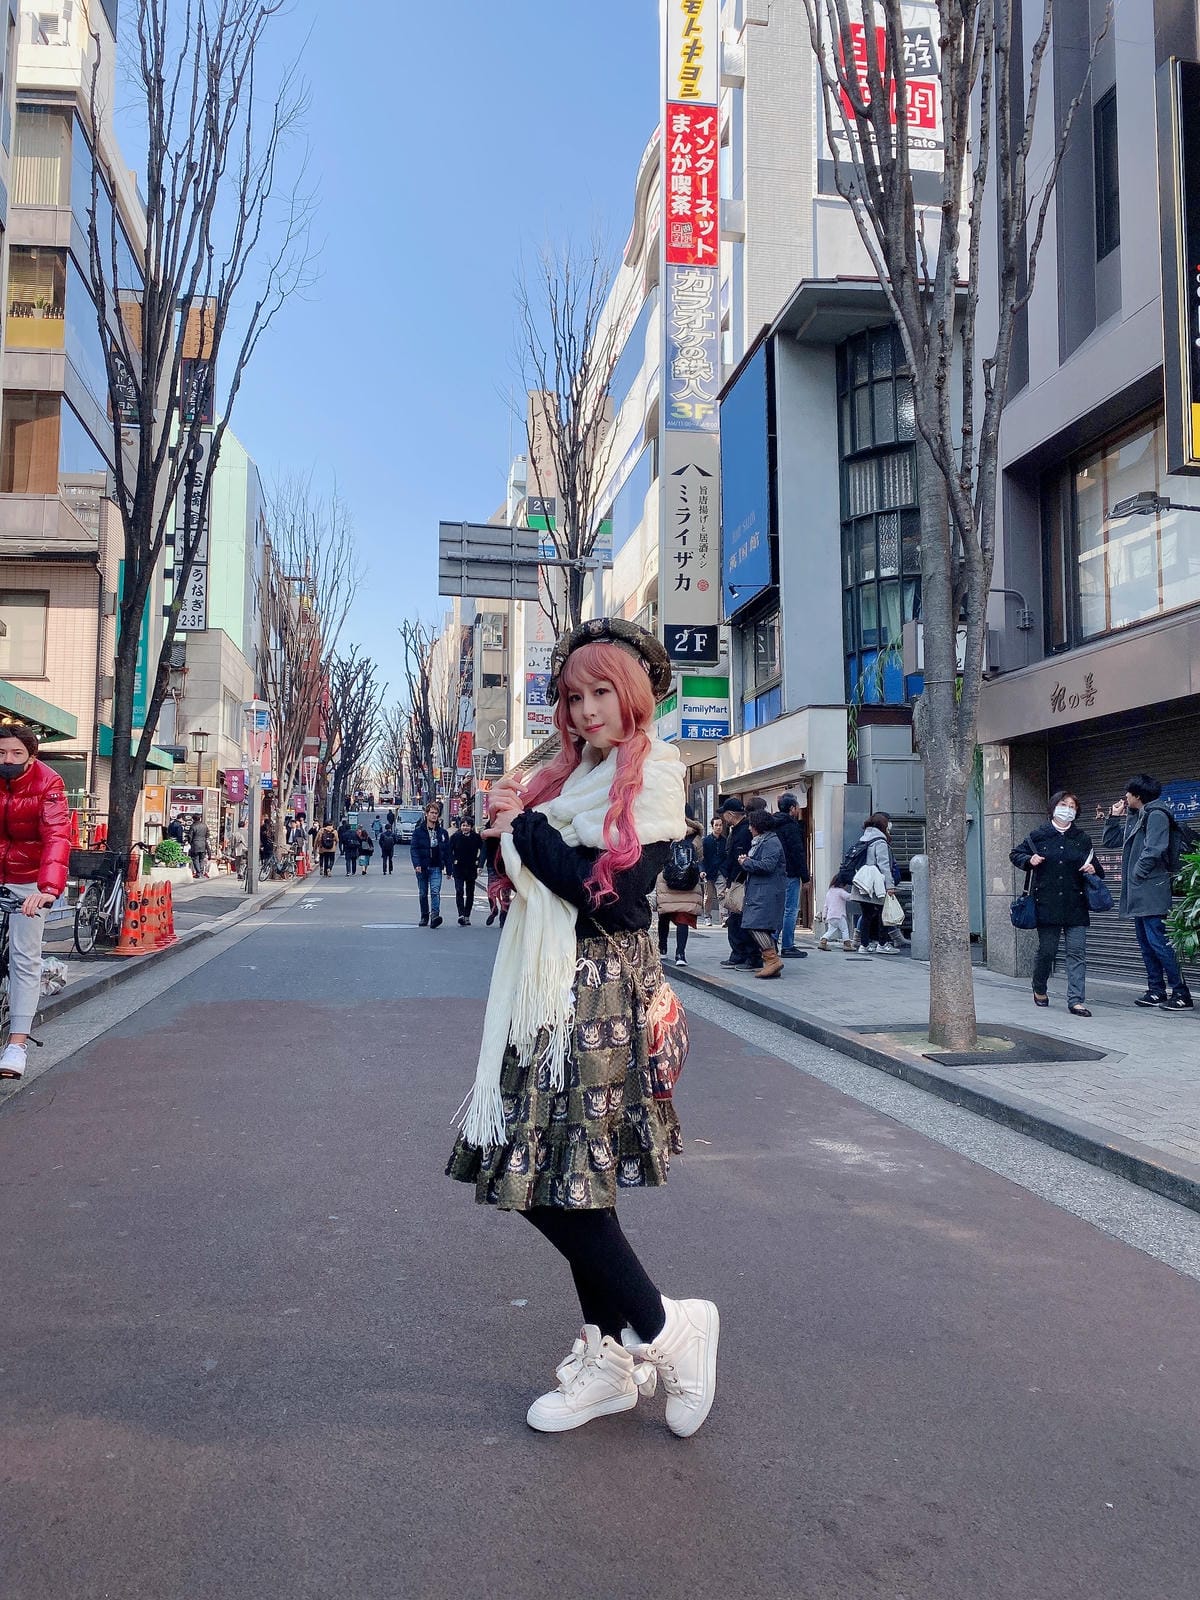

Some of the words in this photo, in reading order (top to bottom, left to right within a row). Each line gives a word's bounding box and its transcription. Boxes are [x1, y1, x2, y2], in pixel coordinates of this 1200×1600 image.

[671, 113, 692, 216] まんが喫茶
[695, 116, 715, 259] インターネット
[671, 269, 715, 402] カラオケの鉄人
[671, 402, 715, 420] 3F
[673, 484, 694, 592] ミライザカ
[191, 568, 205, 612] うなぎ
[674, 632, 708, 653] 2F
[683, 704, 728, 715] FamilyMart
[687, 725, 699, 738] 酒
[701, 726, 724, 738] たばこ
